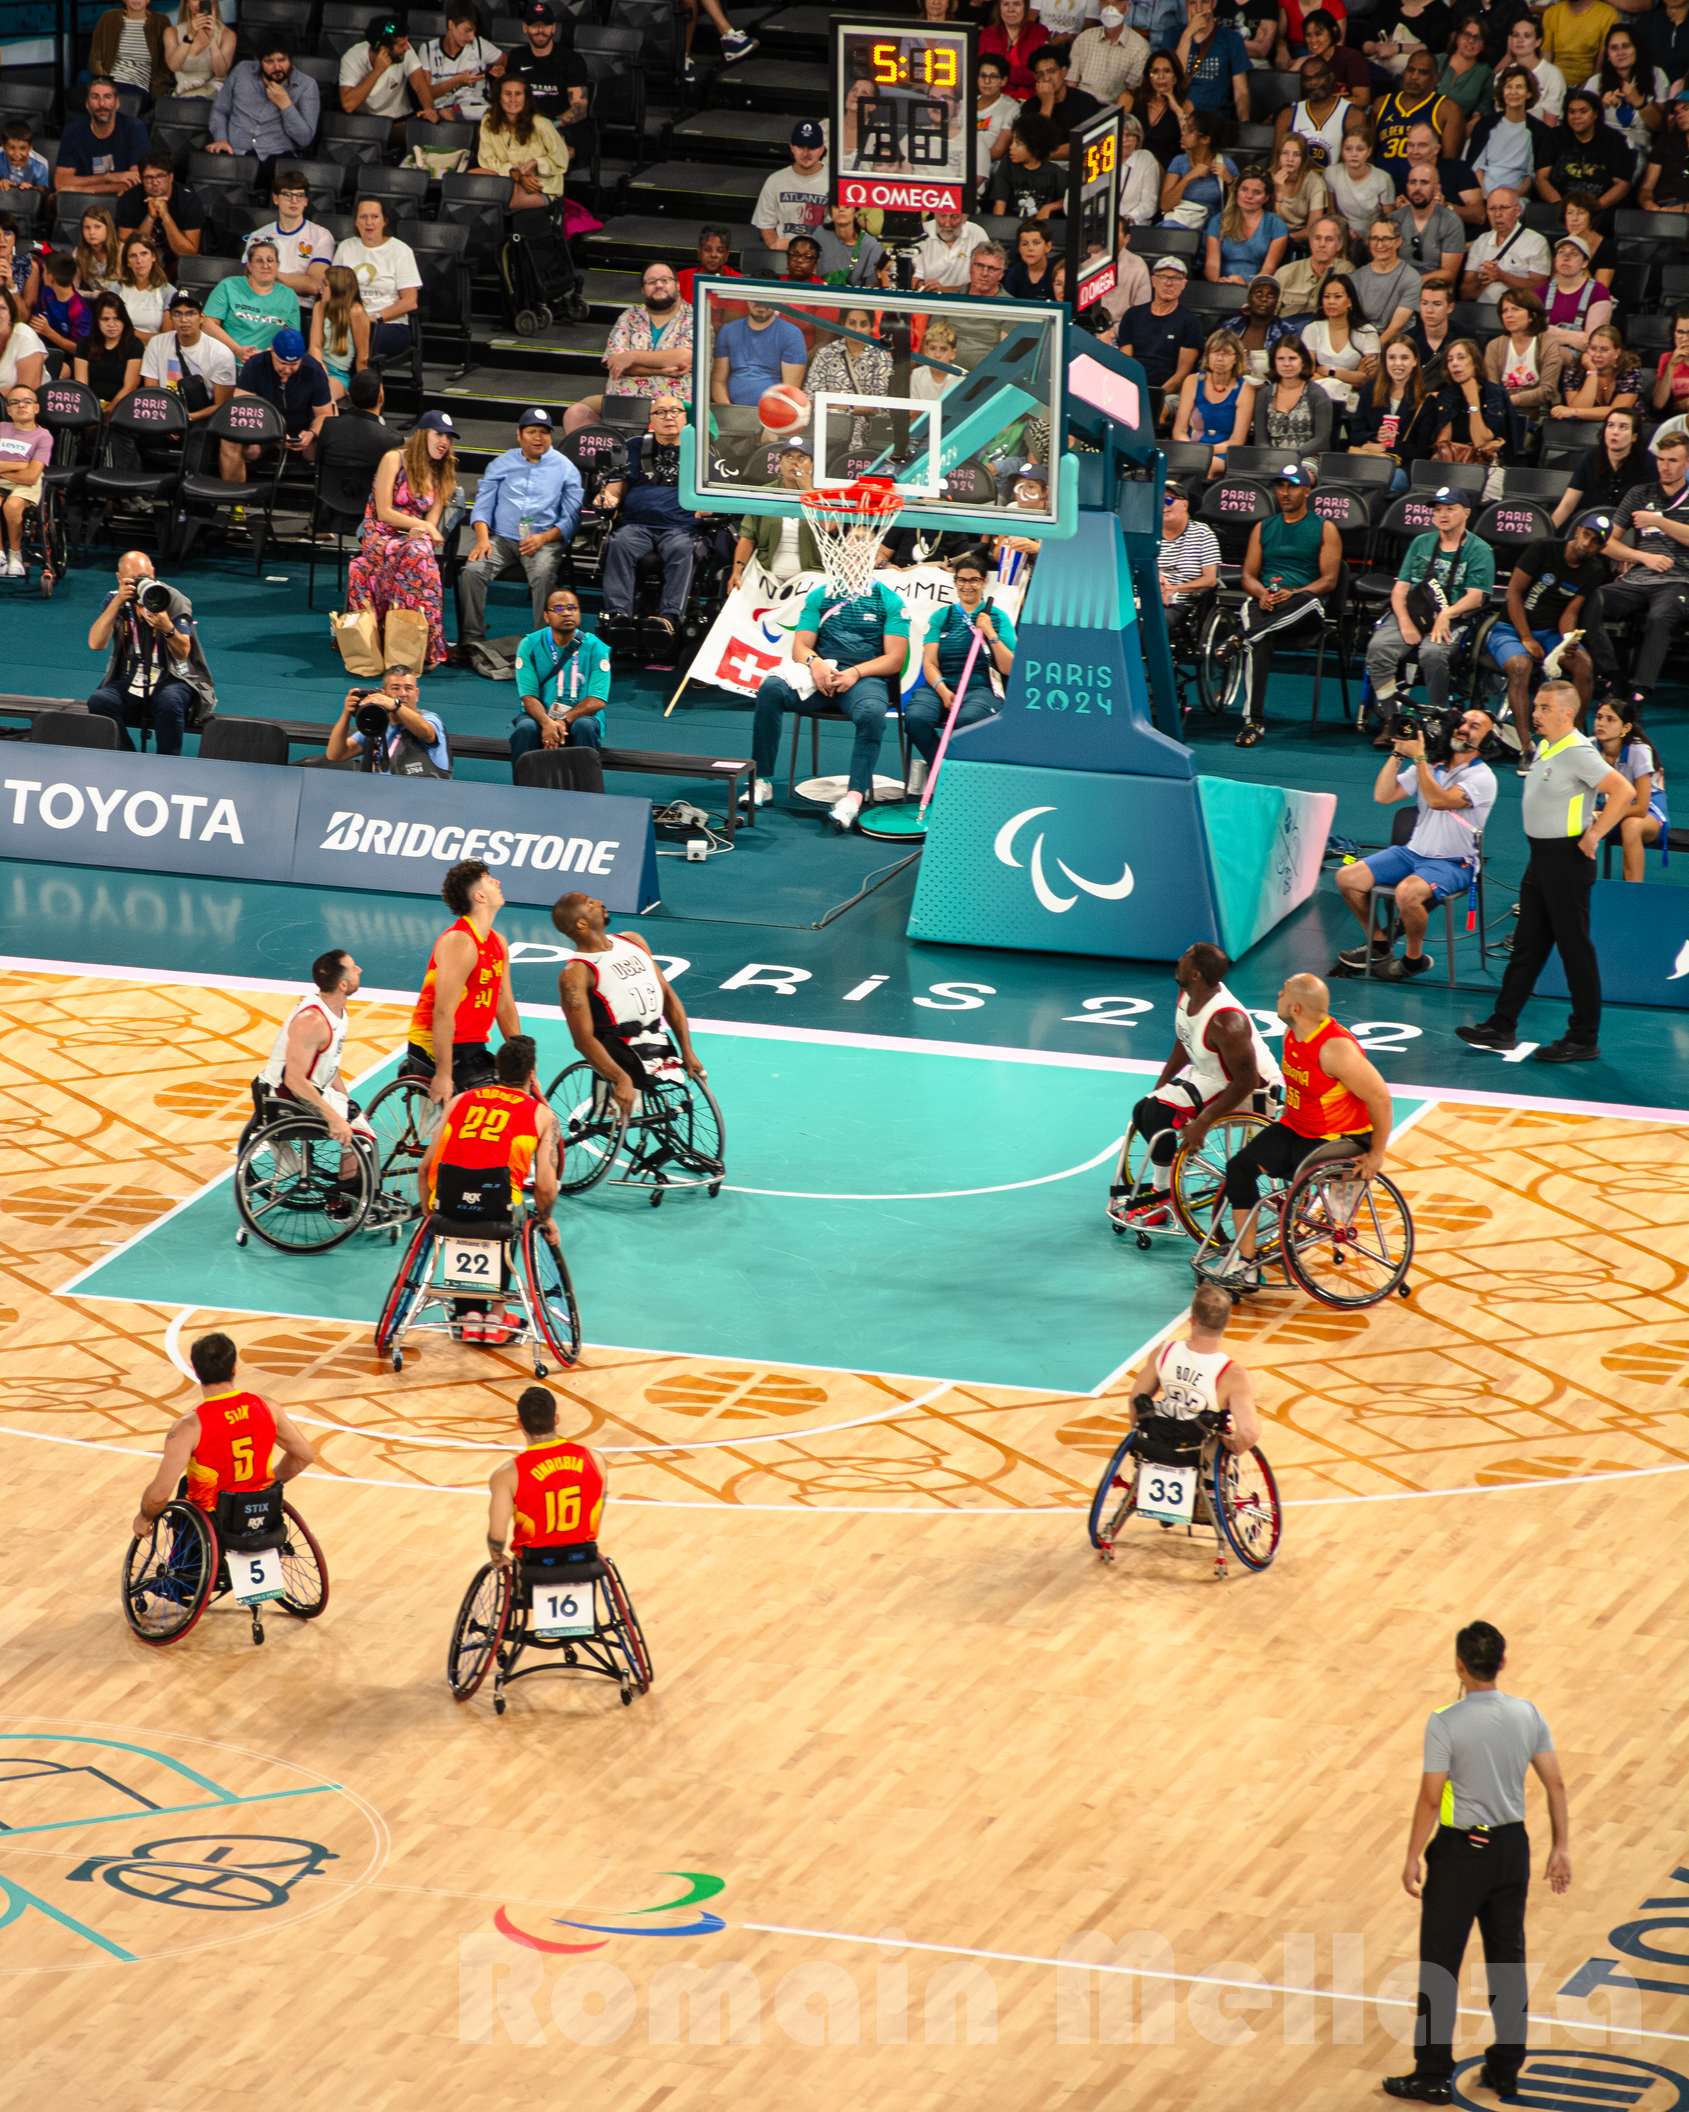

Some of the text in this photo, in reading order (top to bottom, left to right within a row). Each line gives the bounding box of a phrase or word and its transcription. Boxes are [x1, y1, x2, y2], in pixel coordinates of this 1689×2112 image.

[873, 45, 957, 86] 5:13
[871, 186, 957, 209] OMEGA
[1089, 269, 1115, 300] OMEGA
[47, 401, 80, 414] 2024
[133, 409, 167, 421] 2024
[230, 417, 263, 429] 2024
[1220, 501, 1255, 512] 2024
[1496, 521, 1533, 533] 2024
[759, 576, 815, 601] NOU
[1426, 577, 1450, 612] EASTPA
[1025, 687, 1112, 716] 2024
[4, 779, 245, 845] TOYOTA
[319, 811, 620, 875] BRIDGESTONE
[611, 956, 647, 980] USA
[1287, 1086, 1301, 1110] 55
[458, 1105, 511, 1143] 22
[456, 1252, 490, 1276] 22
[1175, 1365, 1204, 1387] BOIE
[231, 1436, 255, 1482] 5
[530, 1456, 585, 1482] ONRUBIA
[1148, 1477, 1184, 1506] 33
[244, 1502, 269, 1514] STIX
[544, 1485, 582, 1535] 16
[250, 1559, 265, 1585] 5
[547, 1594, 579, 1619] 16
